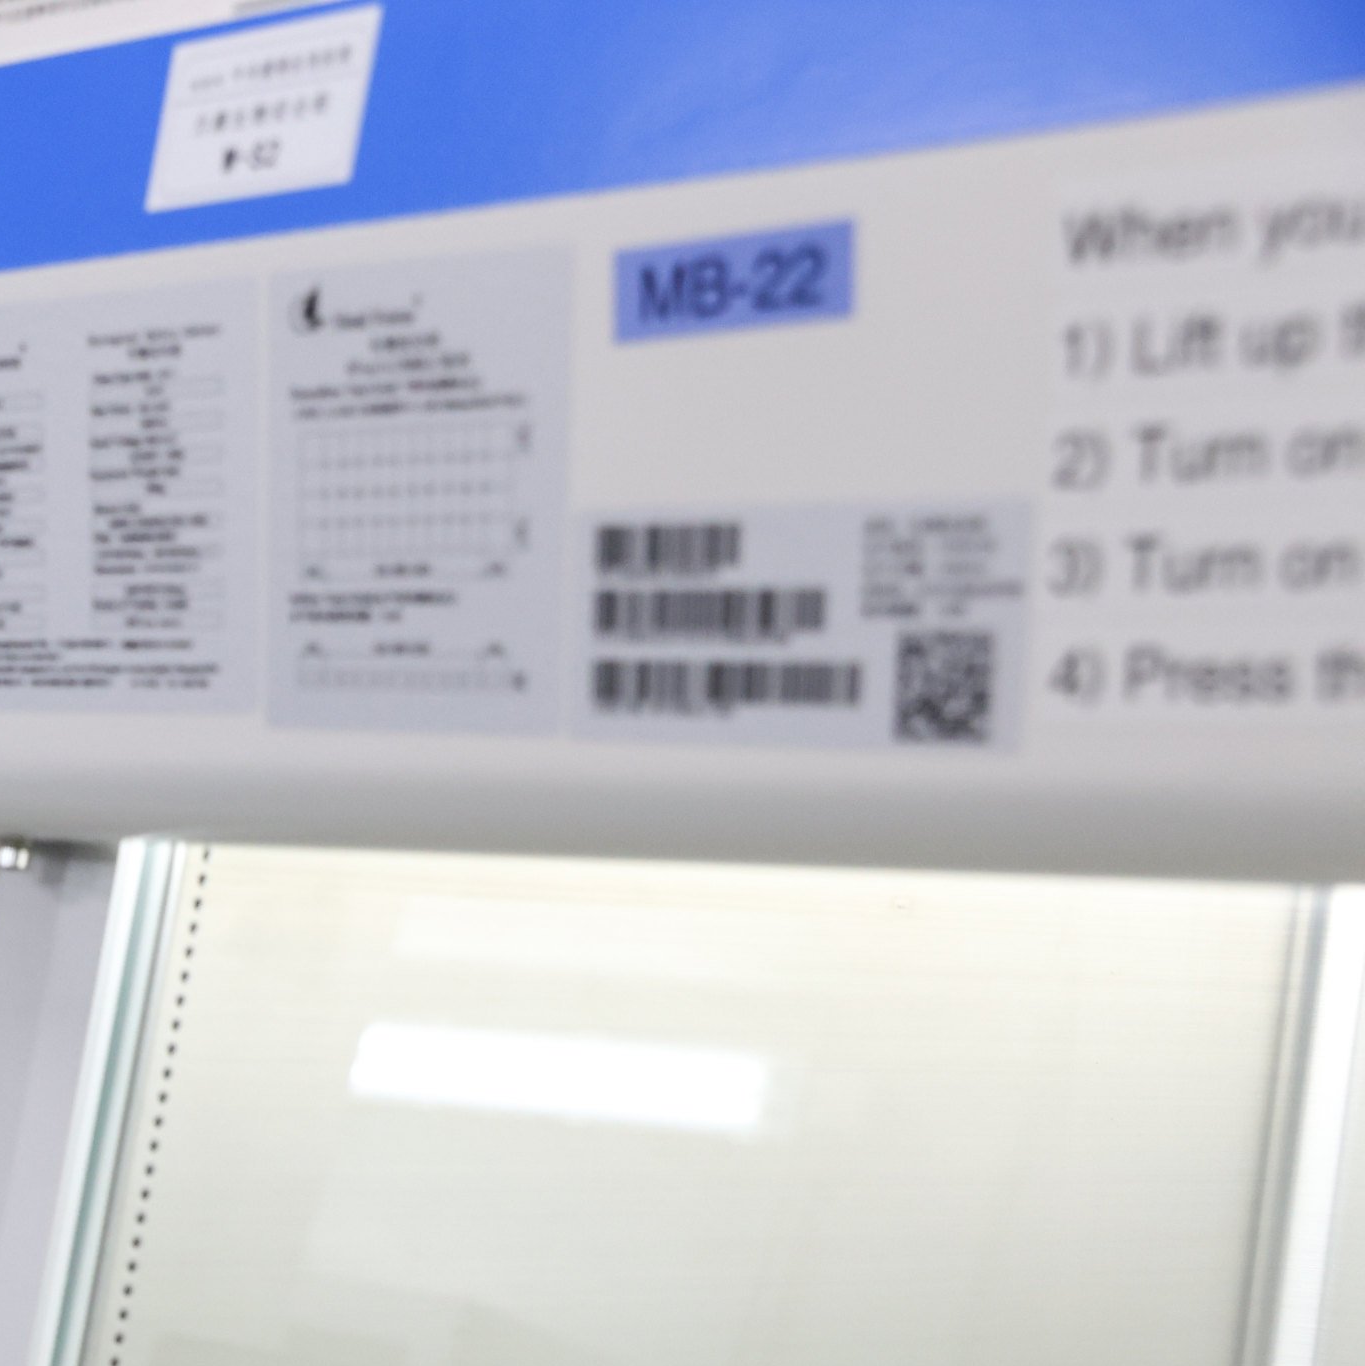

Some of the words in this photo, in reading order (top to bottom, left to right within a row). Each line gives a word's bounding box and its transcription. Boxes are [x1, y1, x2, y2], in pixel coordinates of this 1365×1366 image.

[1064, 204, 1239, 264] When
[638, 243, 830, 322] MB-22
[1065, 320, 1115, 380] 1)
[1131, 312, 1225, 376] Lift
[1132, 423, 1269, 486] Turn
[1126, 531, 1263, 595] Turn
